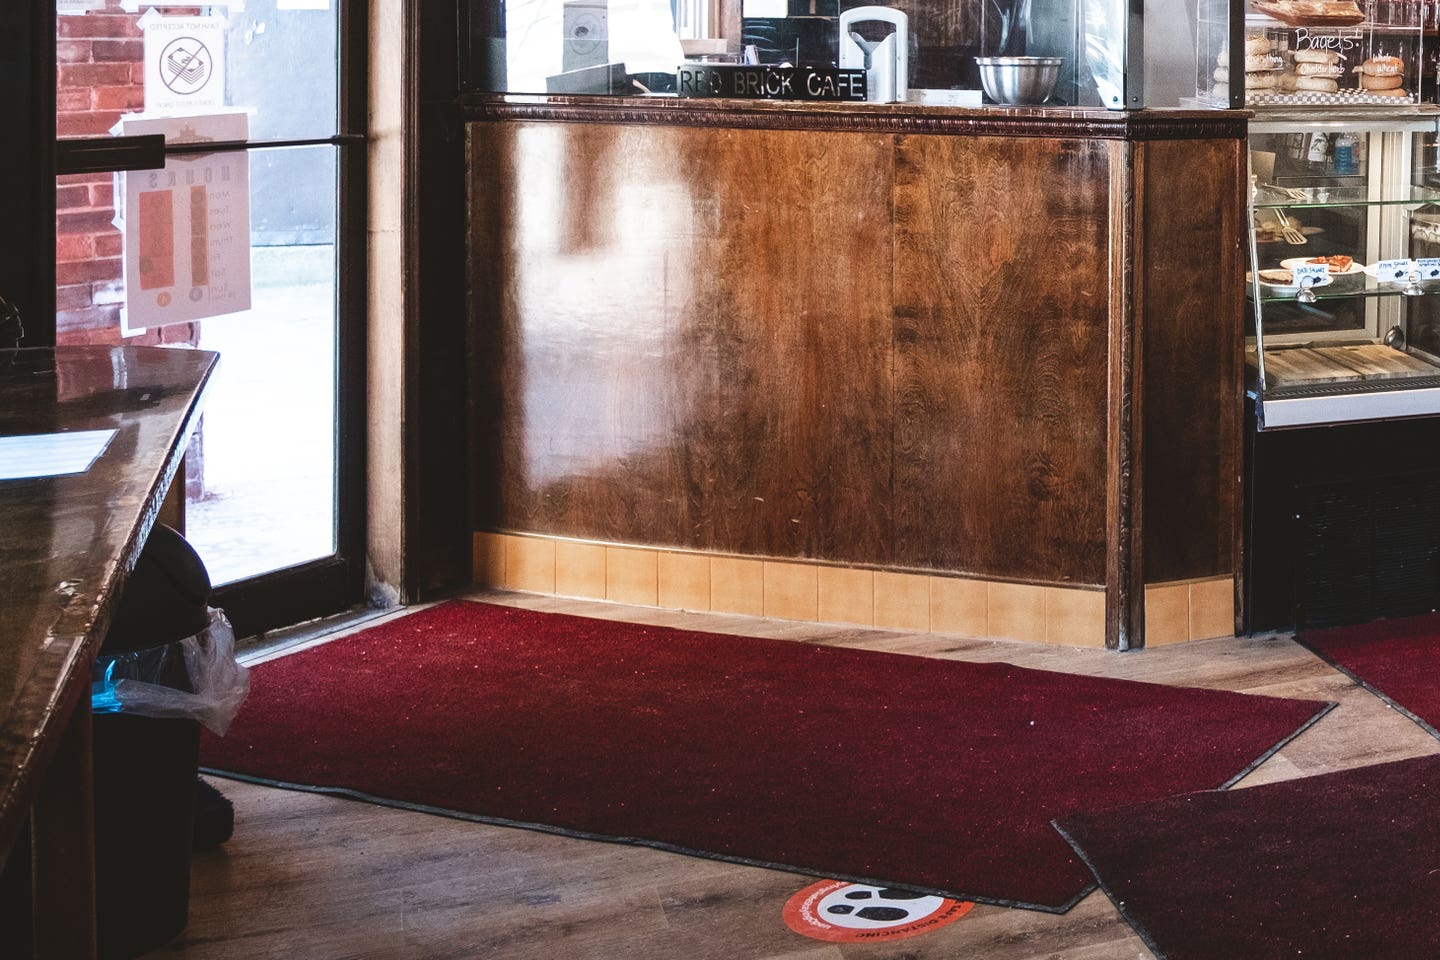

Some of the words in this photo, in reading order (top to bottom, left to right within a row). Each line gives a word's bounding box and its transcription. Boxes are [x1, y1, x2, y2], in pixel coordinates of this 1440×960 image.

[680, 70, 722, 94] RED
[734, 71, 794, 96] BRICK
[807, 73, 863, 97] CAFE
